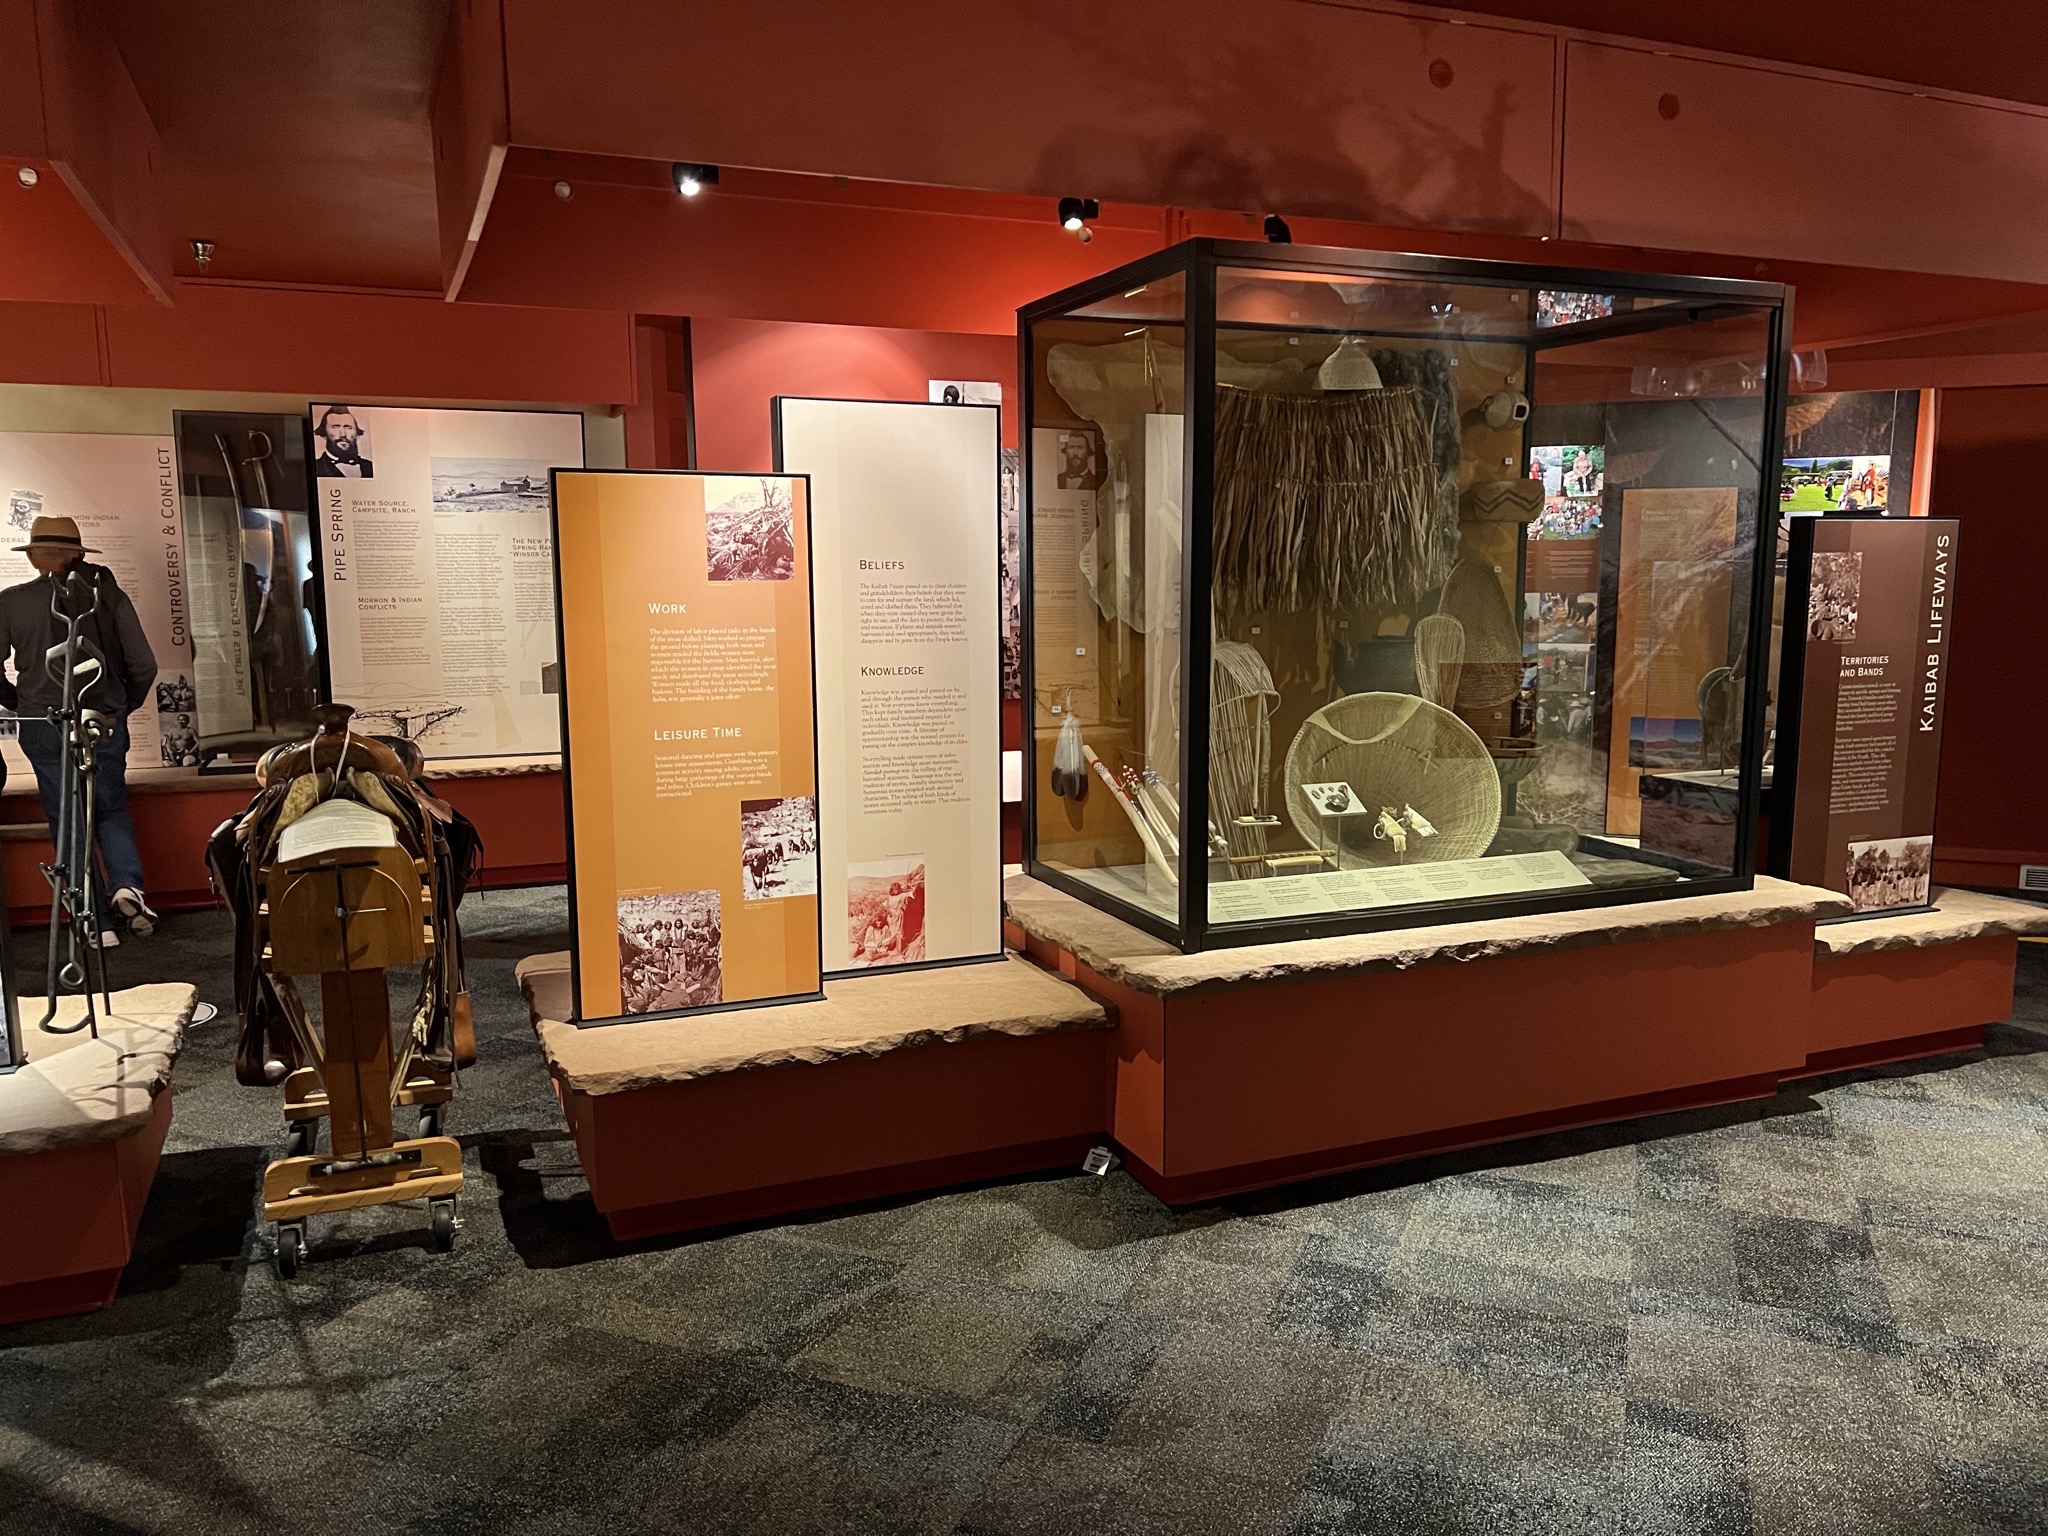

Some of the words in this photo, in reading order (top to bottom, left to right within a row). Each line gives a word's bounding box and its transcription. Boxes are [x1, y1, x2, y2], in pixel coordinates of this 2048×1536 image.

[158, 447, 174, 519] CONFLICT
[330, 489, 345, 543] SPRING
[352, 506, 389, 514] CAMPSITE,
[162, 525, 176, 536] &
[334, 548, 347, 581] PIPE
[859, 560, 905, 570] BELIEFS
[165, 543, 186, 646] CONTROVERSY
[1927, 534, 1950, 644] LIFEWAYS
[358, 603, 397, 611] CONFLICTS
[648, 602, 687, 614] WORK
[1840, 655, 1889, 666] TERRITORIES
[861, 666, 925, 676] KNOWLEDGE
[1839, 669, 1856, 678] AND
[1857, 667, 1884, 677] BANDS
[1919, 653, 1940, 732] KAIBAB
[654, 729, 708, 741] LEISURE
[712, 726, 742, 738] TIME
